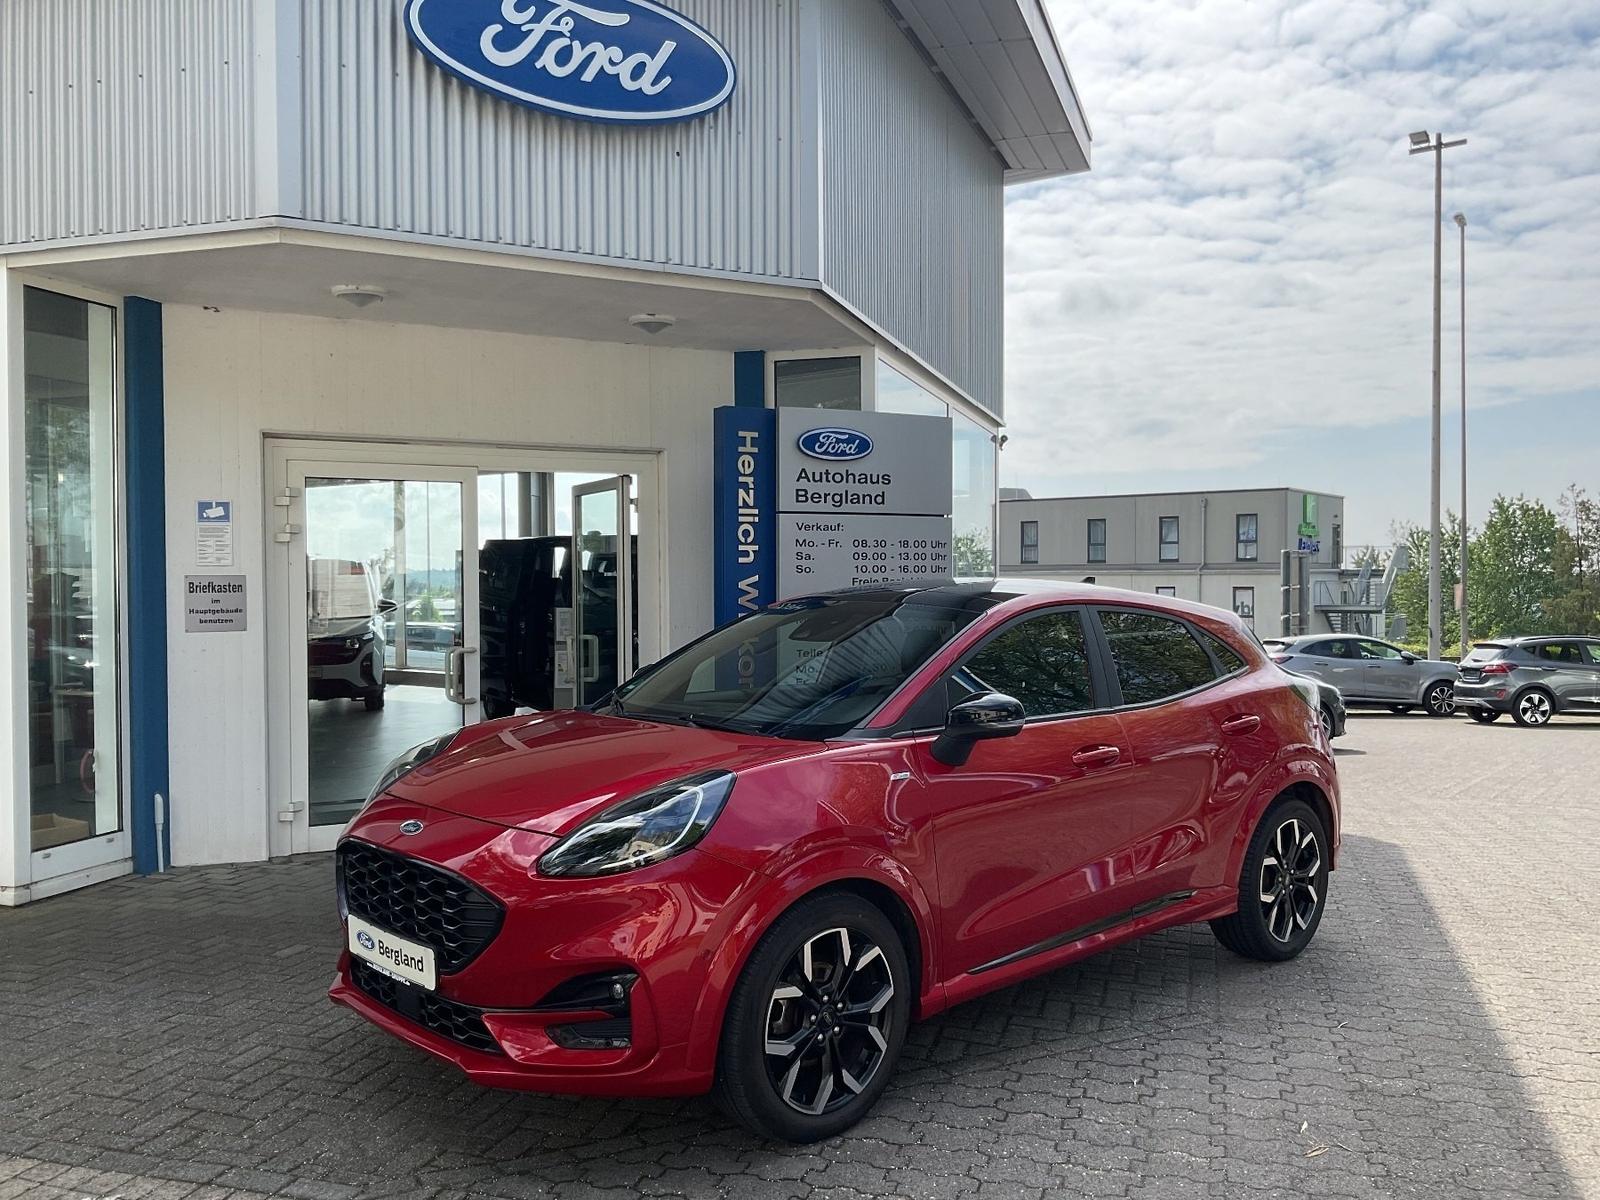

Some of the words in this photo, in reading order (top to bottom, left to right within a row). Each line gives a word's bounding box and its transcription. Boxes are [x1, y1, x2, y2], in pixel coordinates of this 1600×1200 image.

[480, 0, 677, 95] Ford
[815, 433, 859, 454] Ford
[796, 468, 891, 485] Autohaus
[738, 431, 758, 563] Herzlich
[795, 489, 885, 507] Bergland
[796, 522, 844, 532] Verkauf:
[795, 539, 818, 547] Mo.
[828, 539, 842, 548] Fr.
[852, 539, 887, 549] 08.30
[899, 540, 927, 549] 18.00
[930, 541, 948, 549] Uhr
[795, 552, 815, 560] Sa.
[852, 552, 887, 561] 09.00
[899, 552, 927, 561] 13.00
[930, 553, 948, 561] Uhr
[795, 565, 815, 573] So.
[855, 565, 887, 573] 10.00
[899, 564, 927, 574] 16.00
[930, 565, 948, 573] Uhr
[188, 581, 243, 594] Briefkasten
[378, 940, 424, 972] Bergland
